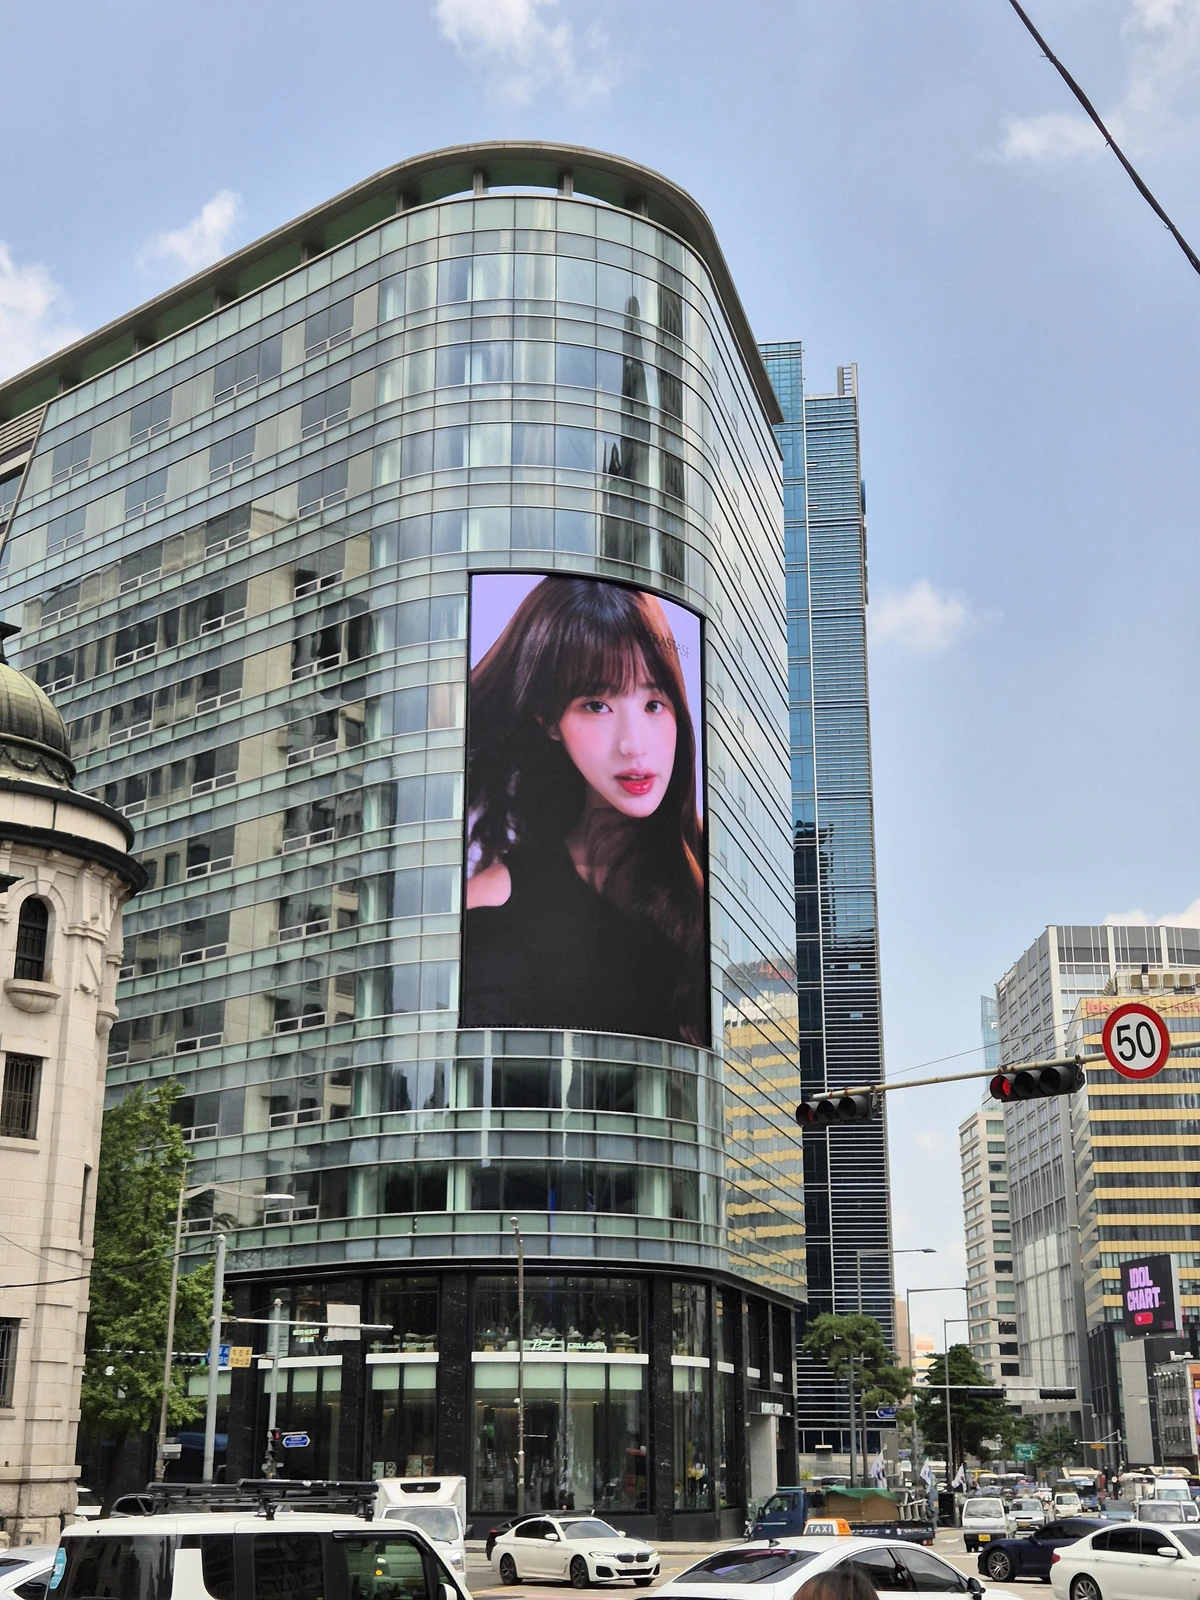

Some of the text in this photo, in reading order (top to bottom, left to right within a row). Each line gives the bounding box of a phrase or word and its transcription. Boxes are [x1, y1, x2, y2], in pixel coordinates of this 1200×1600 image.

[1117, 1021, 1156, 1062] 50
[1129, 1266, 1153, 1288] IDOL
[1127, 1287, 1160, 1311] CHART
[809, 1525, 832, 1534] TAXI
